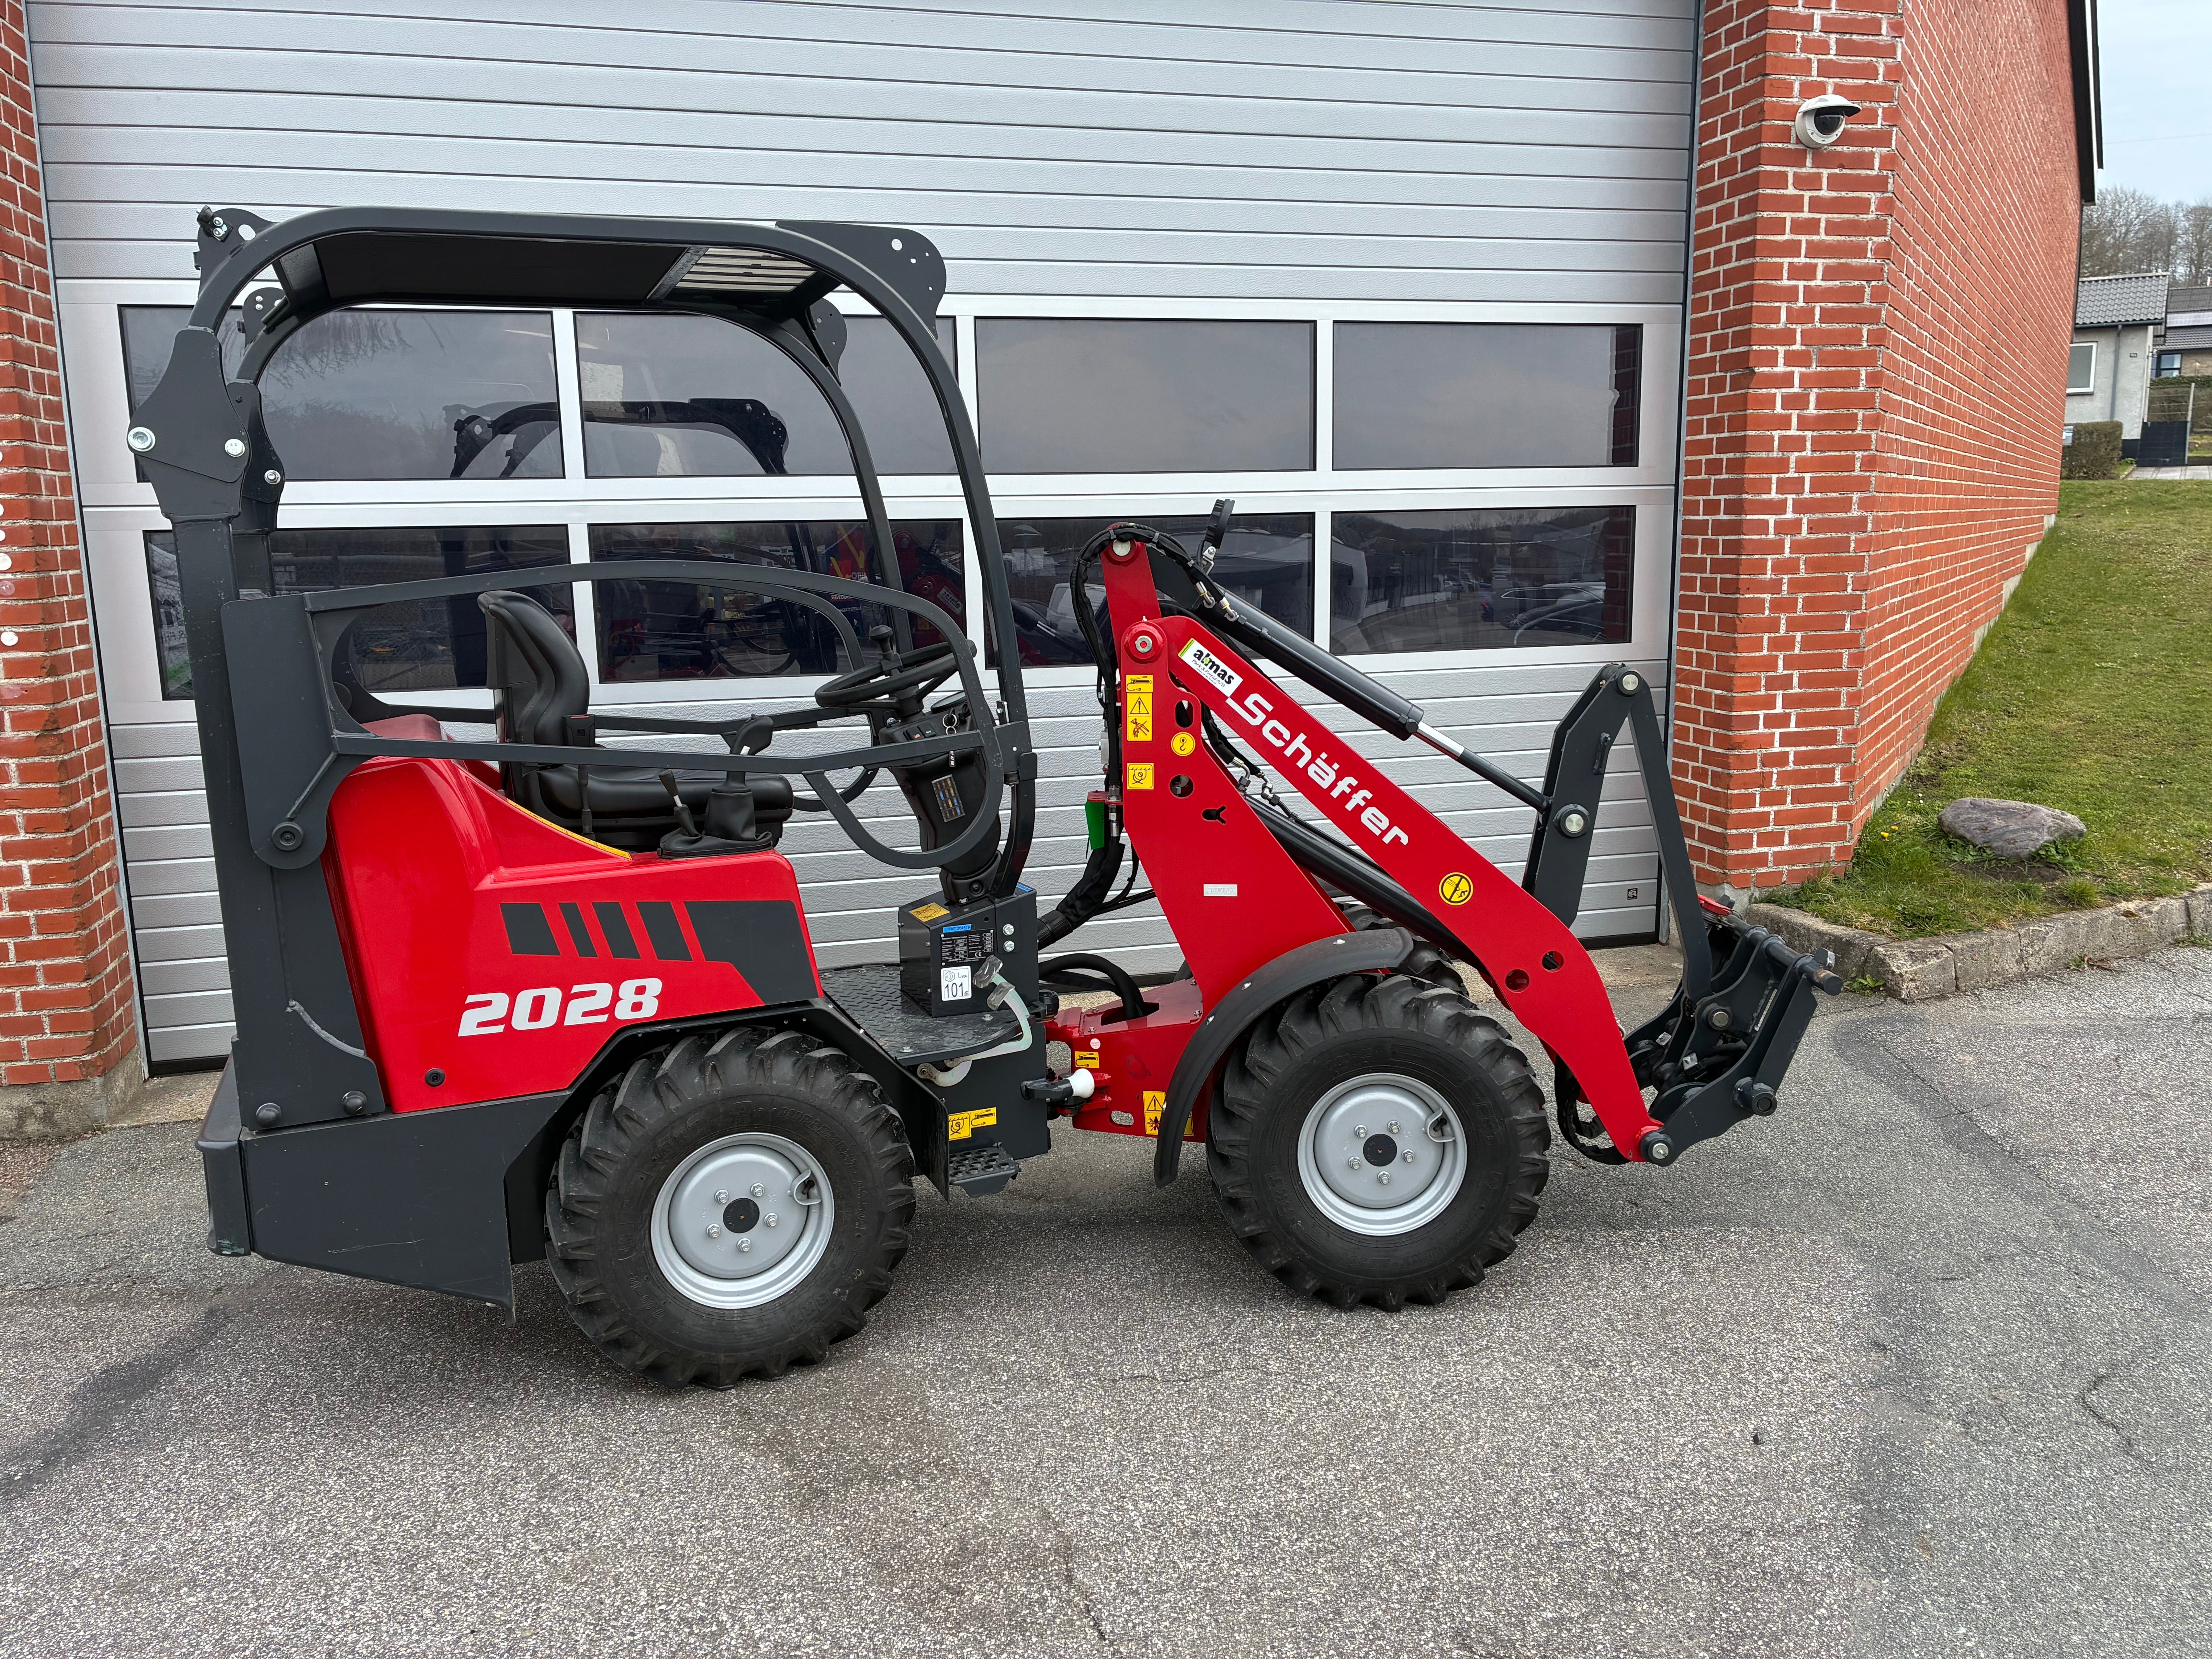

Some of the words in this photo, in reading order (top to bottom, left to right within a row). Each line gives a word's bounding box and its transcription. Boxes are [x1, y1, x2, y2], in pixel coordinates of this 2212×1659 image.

[1192, 659, 1202, 668] Park
[1193, 649, 1234, 685] almas
[1226, 693, 1408, 845] Schäffer
[458, 977, 663, 1037] 2028
[945, 982, 963, 998] 101
